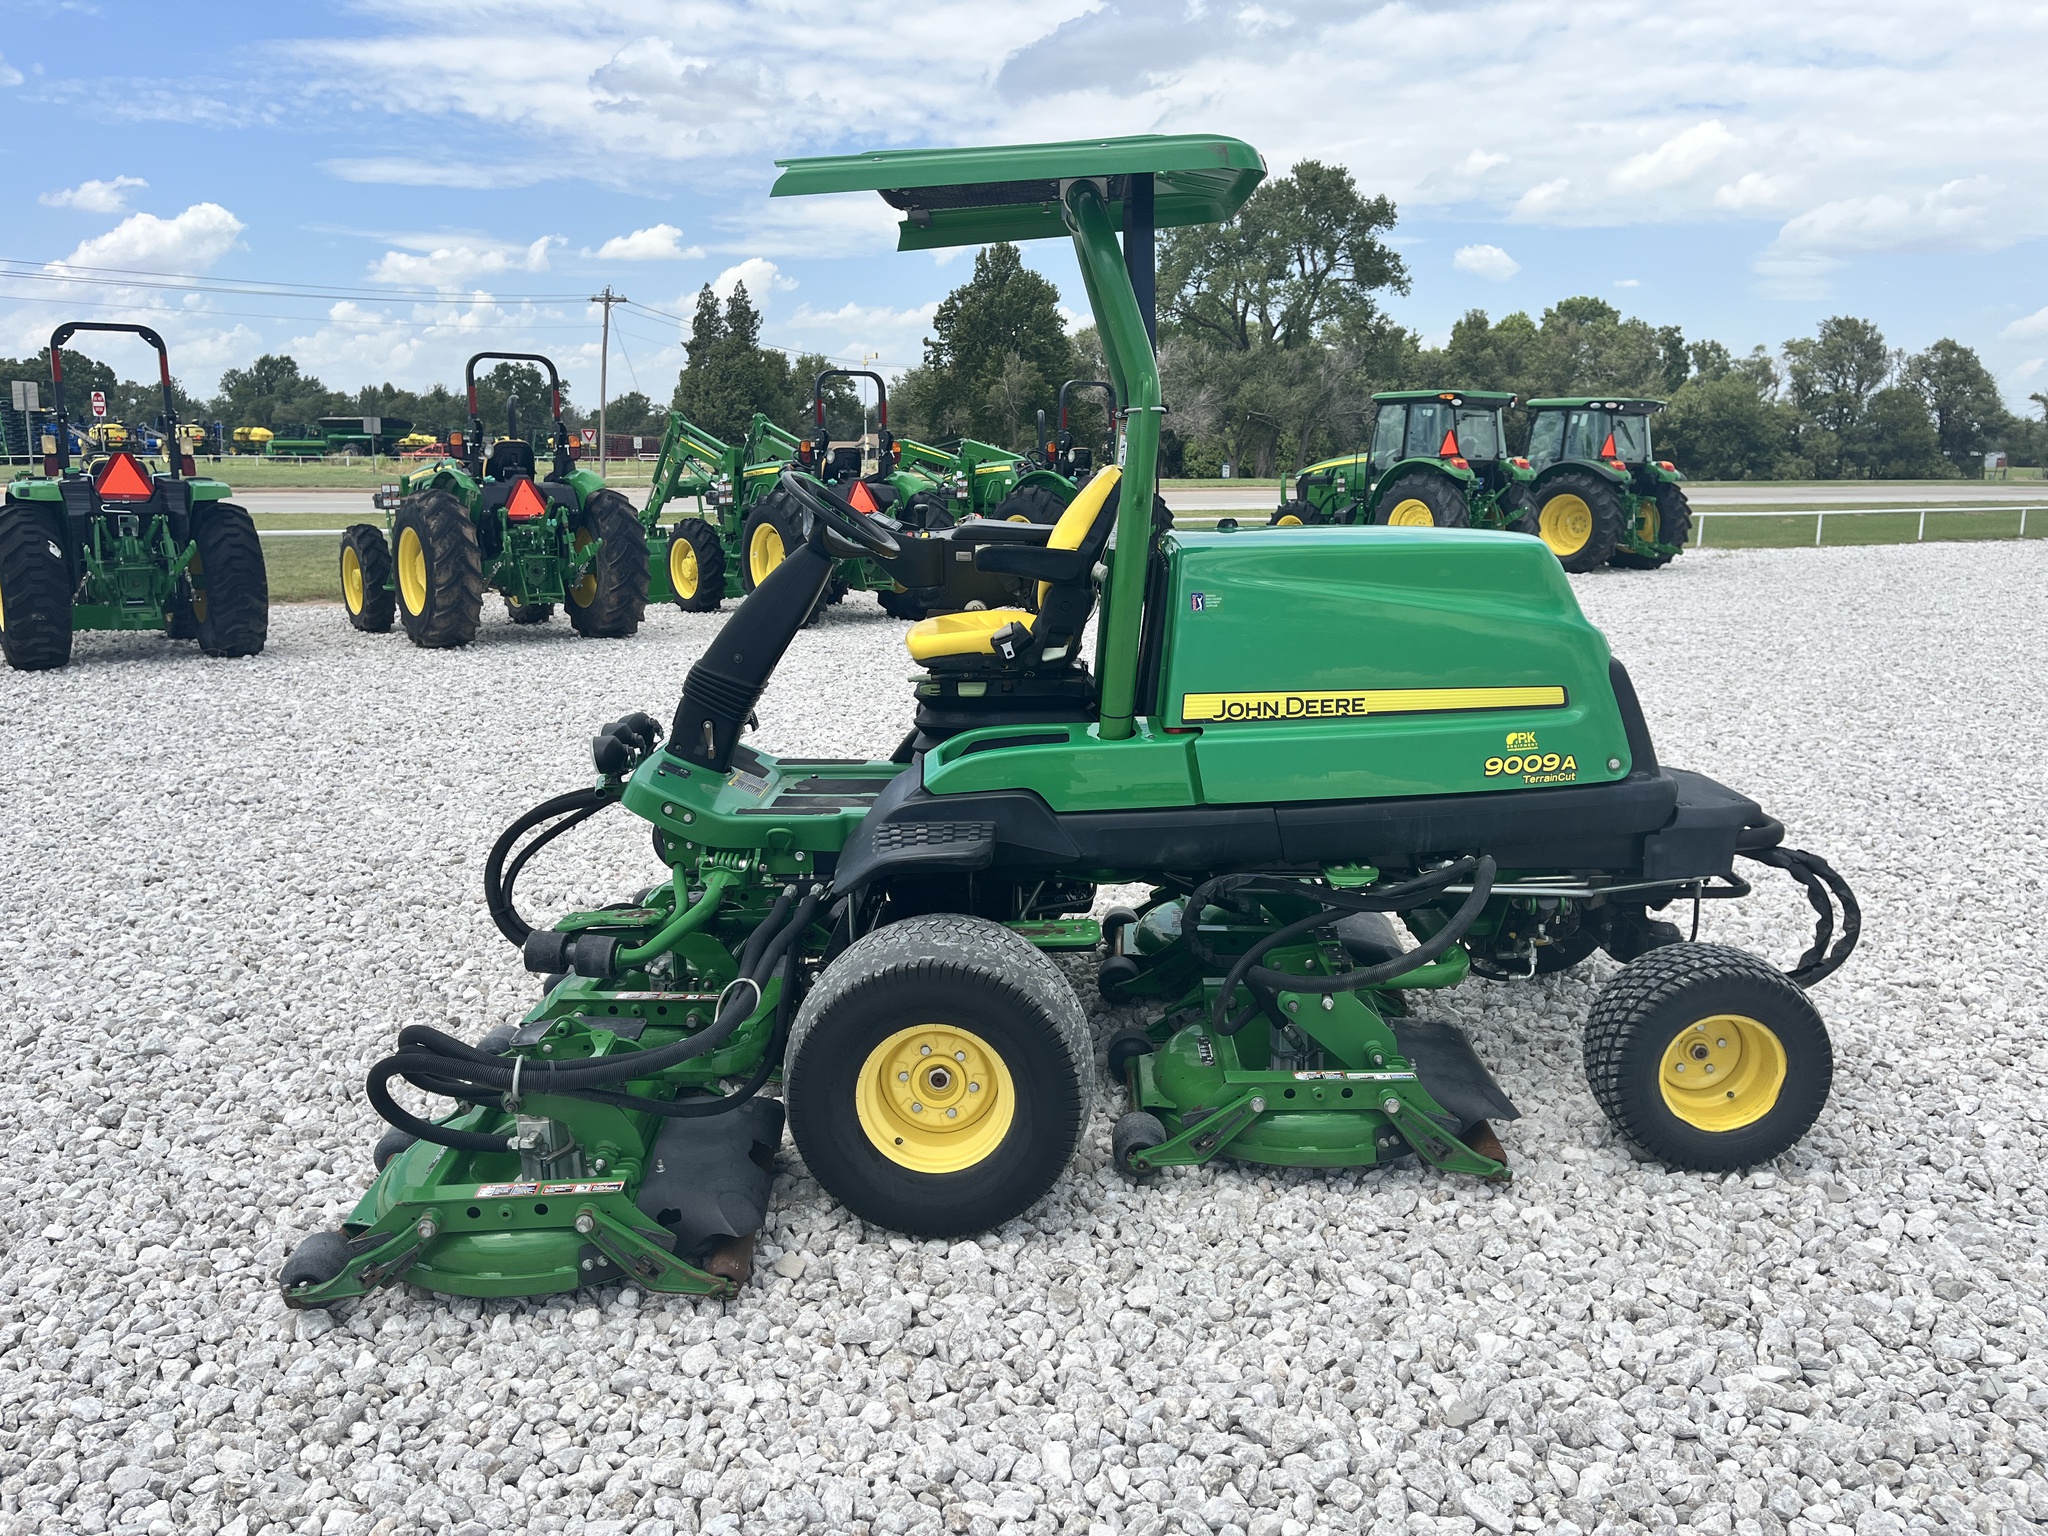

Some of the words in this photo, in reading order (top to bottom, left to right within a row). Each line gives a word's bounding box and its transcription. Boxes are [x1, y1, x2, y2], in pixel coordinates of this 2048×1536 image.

[1212, 699, 1279, 720] JOHN
[1285, 696, 1366, 716] DEERE
[1523, 773, 1576, 784] TerrainCut
